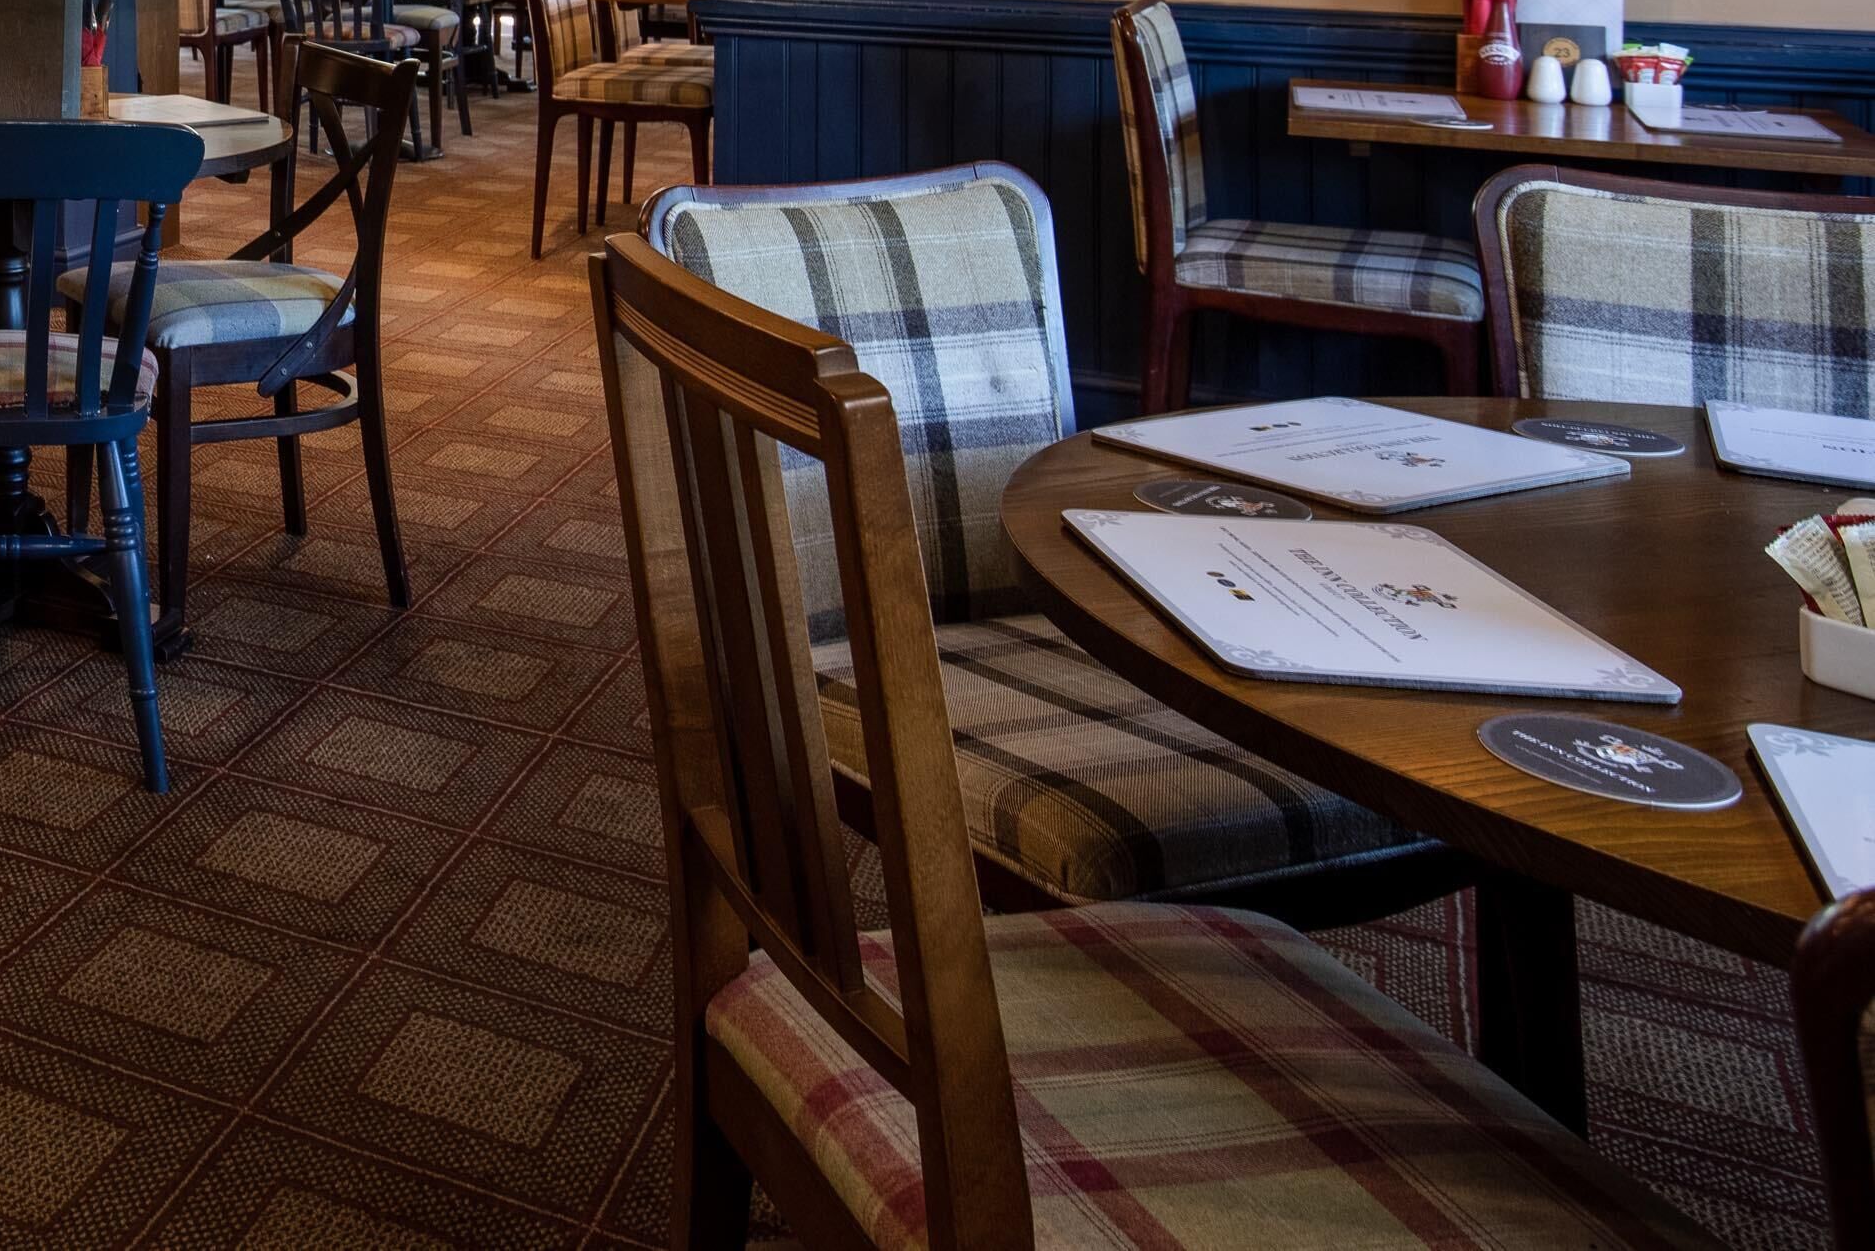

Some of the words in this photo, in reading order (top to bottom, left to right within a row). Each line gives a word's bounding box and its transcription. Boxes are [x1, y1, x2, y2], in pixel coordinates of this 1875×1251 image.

[1555, 48, 1571, 58] 23
[1288, 548, 1324, 566] THE
[1311, 565, 1347, 584] INN
[1336, 580, 1429, 641] COLLECTION
